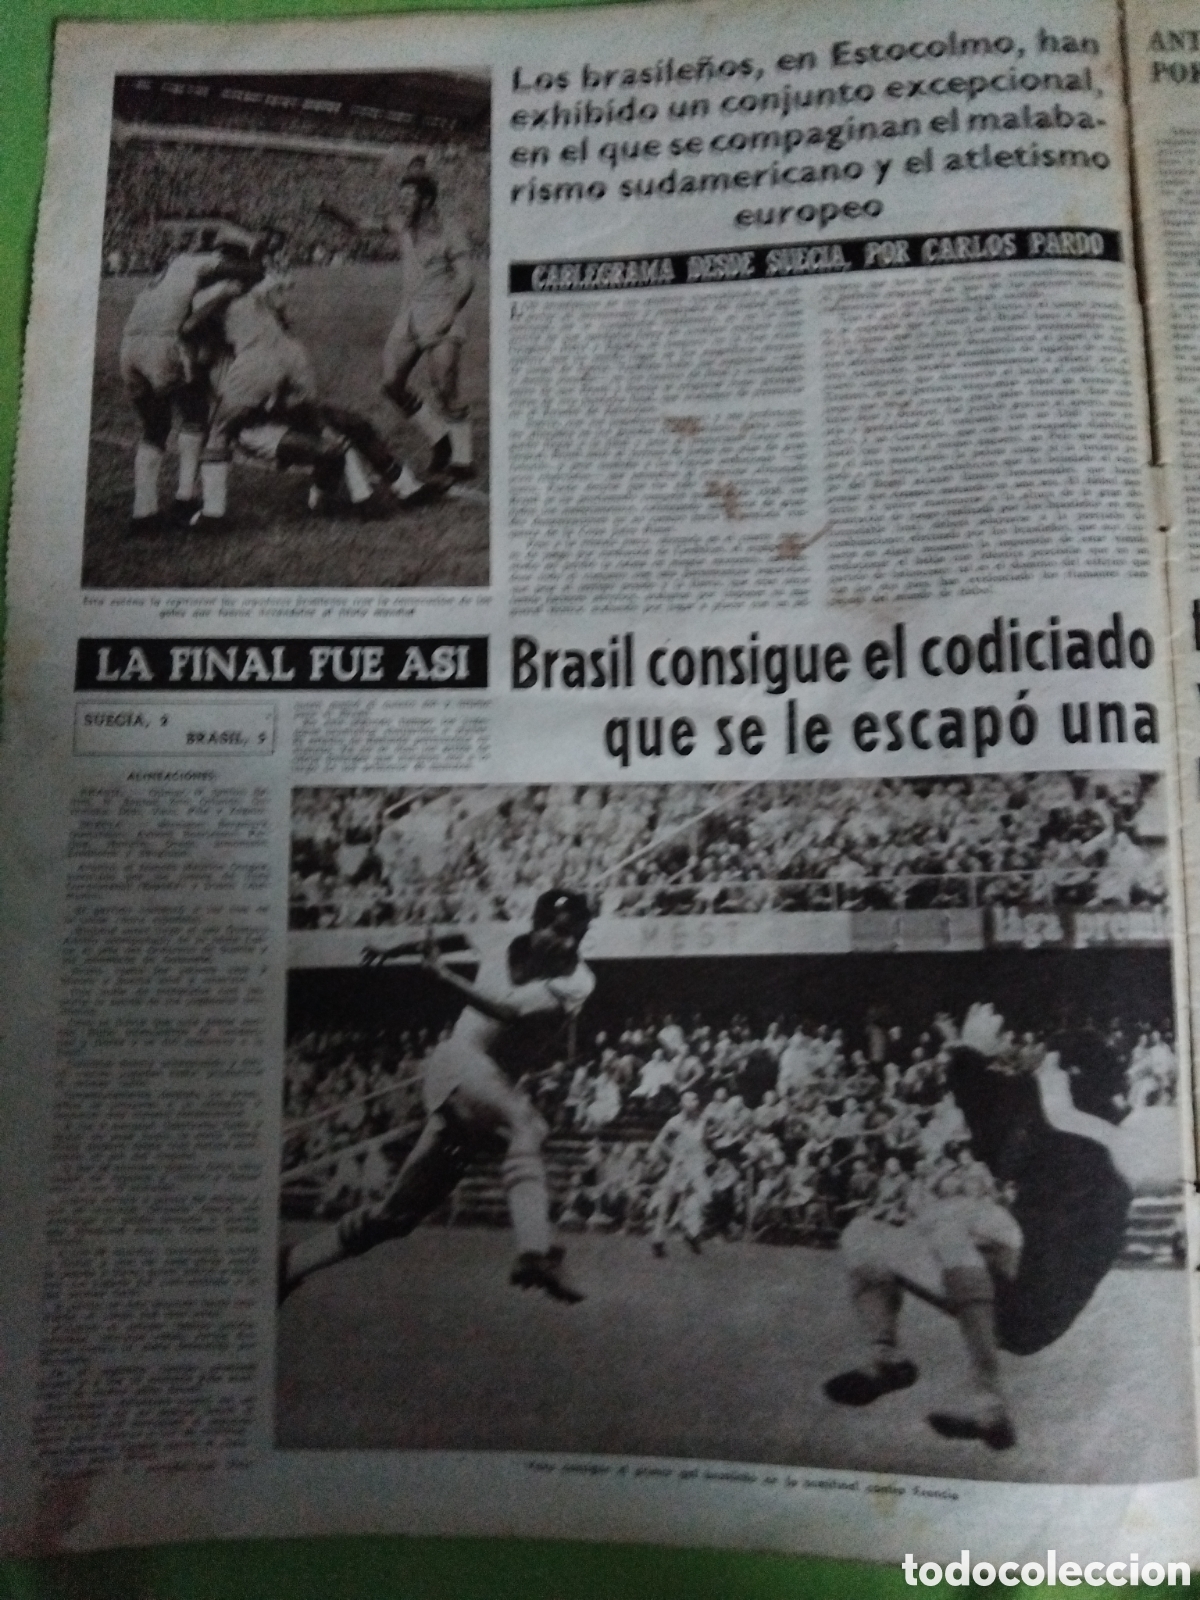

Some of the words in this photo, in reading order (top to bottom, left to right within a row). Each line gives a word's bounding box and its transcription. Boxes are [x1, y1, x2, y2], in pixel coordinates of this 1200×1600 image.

[512, 65, 570, 93] Los
[582, 55, 764, 86] brasileños,
[776, 50, 817, 71] en
[832, 30, 1025, 68] Estocolmo,
[1036, 27, 1100, 54] han
[510, 97, 659, 129] exhibido
[668, 98, 710, 118] un
[720, 83, 875, 118] conjunto
[886, 67, 1104, 100] excepcional,
[510, 146, 549, 166] en
[560, 136, 589, 165] el
[599, 139, 661, 170] que
[669, 136, 703, 156] se
[709, 114, 922, 156] compaginan
[930, 106, 959, 133] el
[967, 103, 1106, 131] malaba-
[510, 177, 607, 205] rismo
[618, 160, 864, 198] sudamericano
[875, 158, 893, 186] y
[905, 147, 933, 174] el
[946, 143, 1111, 172] atletismo
[734, 198, 884, 231] europeo
[531, 258, 676, 292] CABLEGRAMA
[686, 251, 756, 283] DESDE
[864, 240, 911, 267] POR
[920, 232, 1017, 264] CARLOS
[1027, 230, 1105, 259] PARDO
[96, 645, 154, 682] LA
[168, 645, 296, 682] FINAL
[308, 645, 385, 682] FUE
[398, 643, 470, 681] ASI
[511, 631, 634, 690] Brasil
[648, 630, 850, 695] consigue
[865, 621, 906, 680] el
[921, 610, 1155, 676] codiciado
[84, 713, 150, 729] SUECIA,
[605, 715, 697, 768] que
[714, 714, 766, 756] se
[786, 697, 832, 755] le
[853, 688, 1039, 758] escapó
[1061, 700, 1160, 744] una
